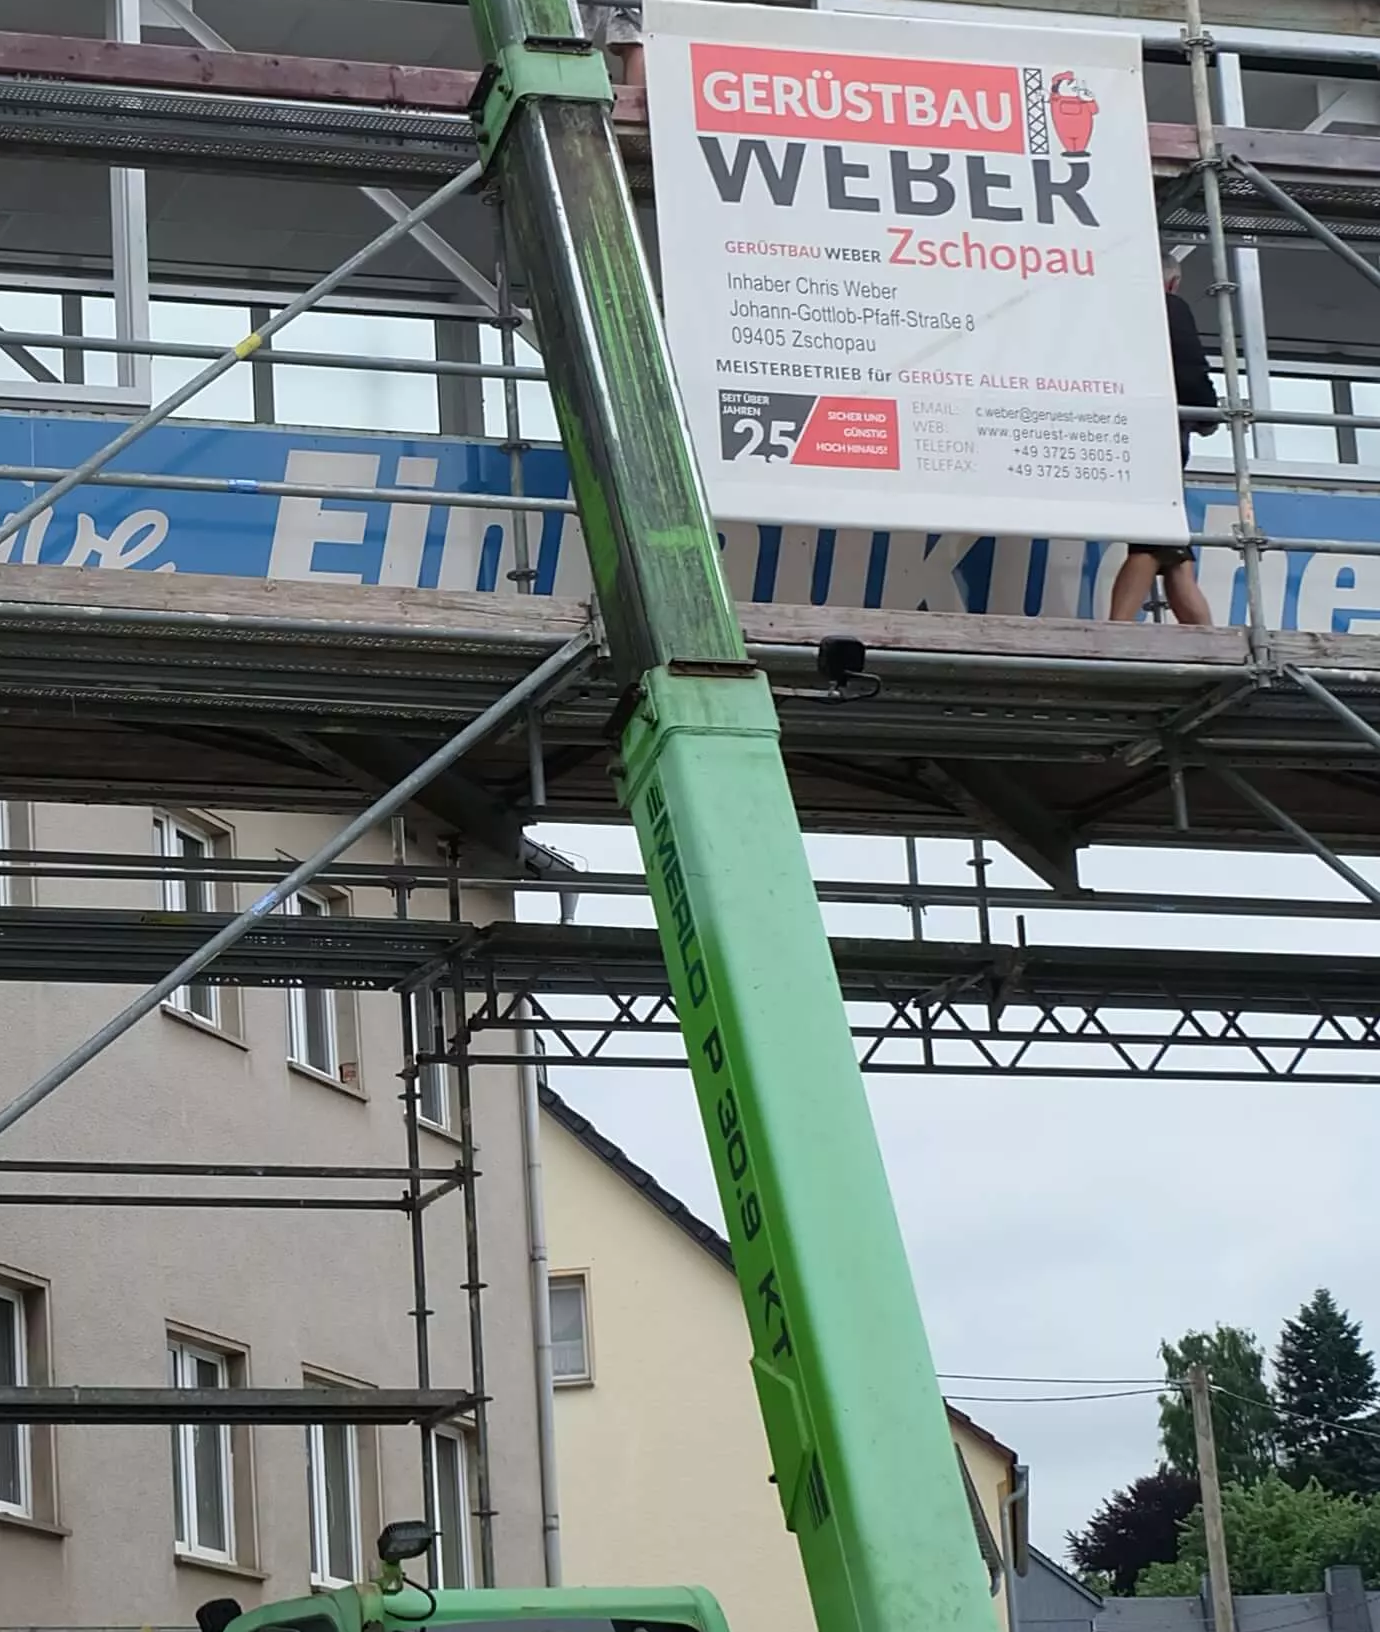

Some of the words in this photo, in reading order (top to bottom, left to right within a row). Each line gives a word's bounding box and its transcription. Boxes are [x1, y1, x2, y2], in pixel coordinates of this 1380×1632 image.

[702, 70, 1013, 132] GERÜSTBAU
[697, 135, 1100, 228] WEBER
[725, 240, 820, 259] GERÜSTBAU
[824, 247, 881, 263] WEBER
[887, 228, 1094, 279] Zschopau
[727, 272, 790, 293] Inhaber
[796, 276, 839, 297] Chris
[844, 280, 898, 300] Weber
[730, 300, 962, 330] Johann-Gottlob-Pfaff-Straße
[965, 314, 976, 332] 8
[732, 326, 786, 347] 09405
[792, 330, 877, 355] Zschopau
[716, 359, 861, 381] MEISTERBETRIEB
[868, 367, 892, 382] für
[899, 368, 974, 387] GERÜSTE
[980, 374, 1029, 390] ALLER
[1036, 377, 1125, 395] BAUARTEN
[721, 393, 741, 403] SEIT
[744, 393, 770, 405] ÜBER
[722, 406, 761, 416] JAHREN
[733, 418, 797, 463] 25
[1014, 445, 1038, 458] +49
[1043, 446, 1076, 460] 3725
[1008, 463, 1032, 476] +49
[1037, 464, 1070, 478] 3725
[653, 818, 708, 1009] MERLO
[701, 1025, 725, 1075] P
[717, 1089, 762, 1243] 30.9
[757, 1267, 793, 1361] KT
